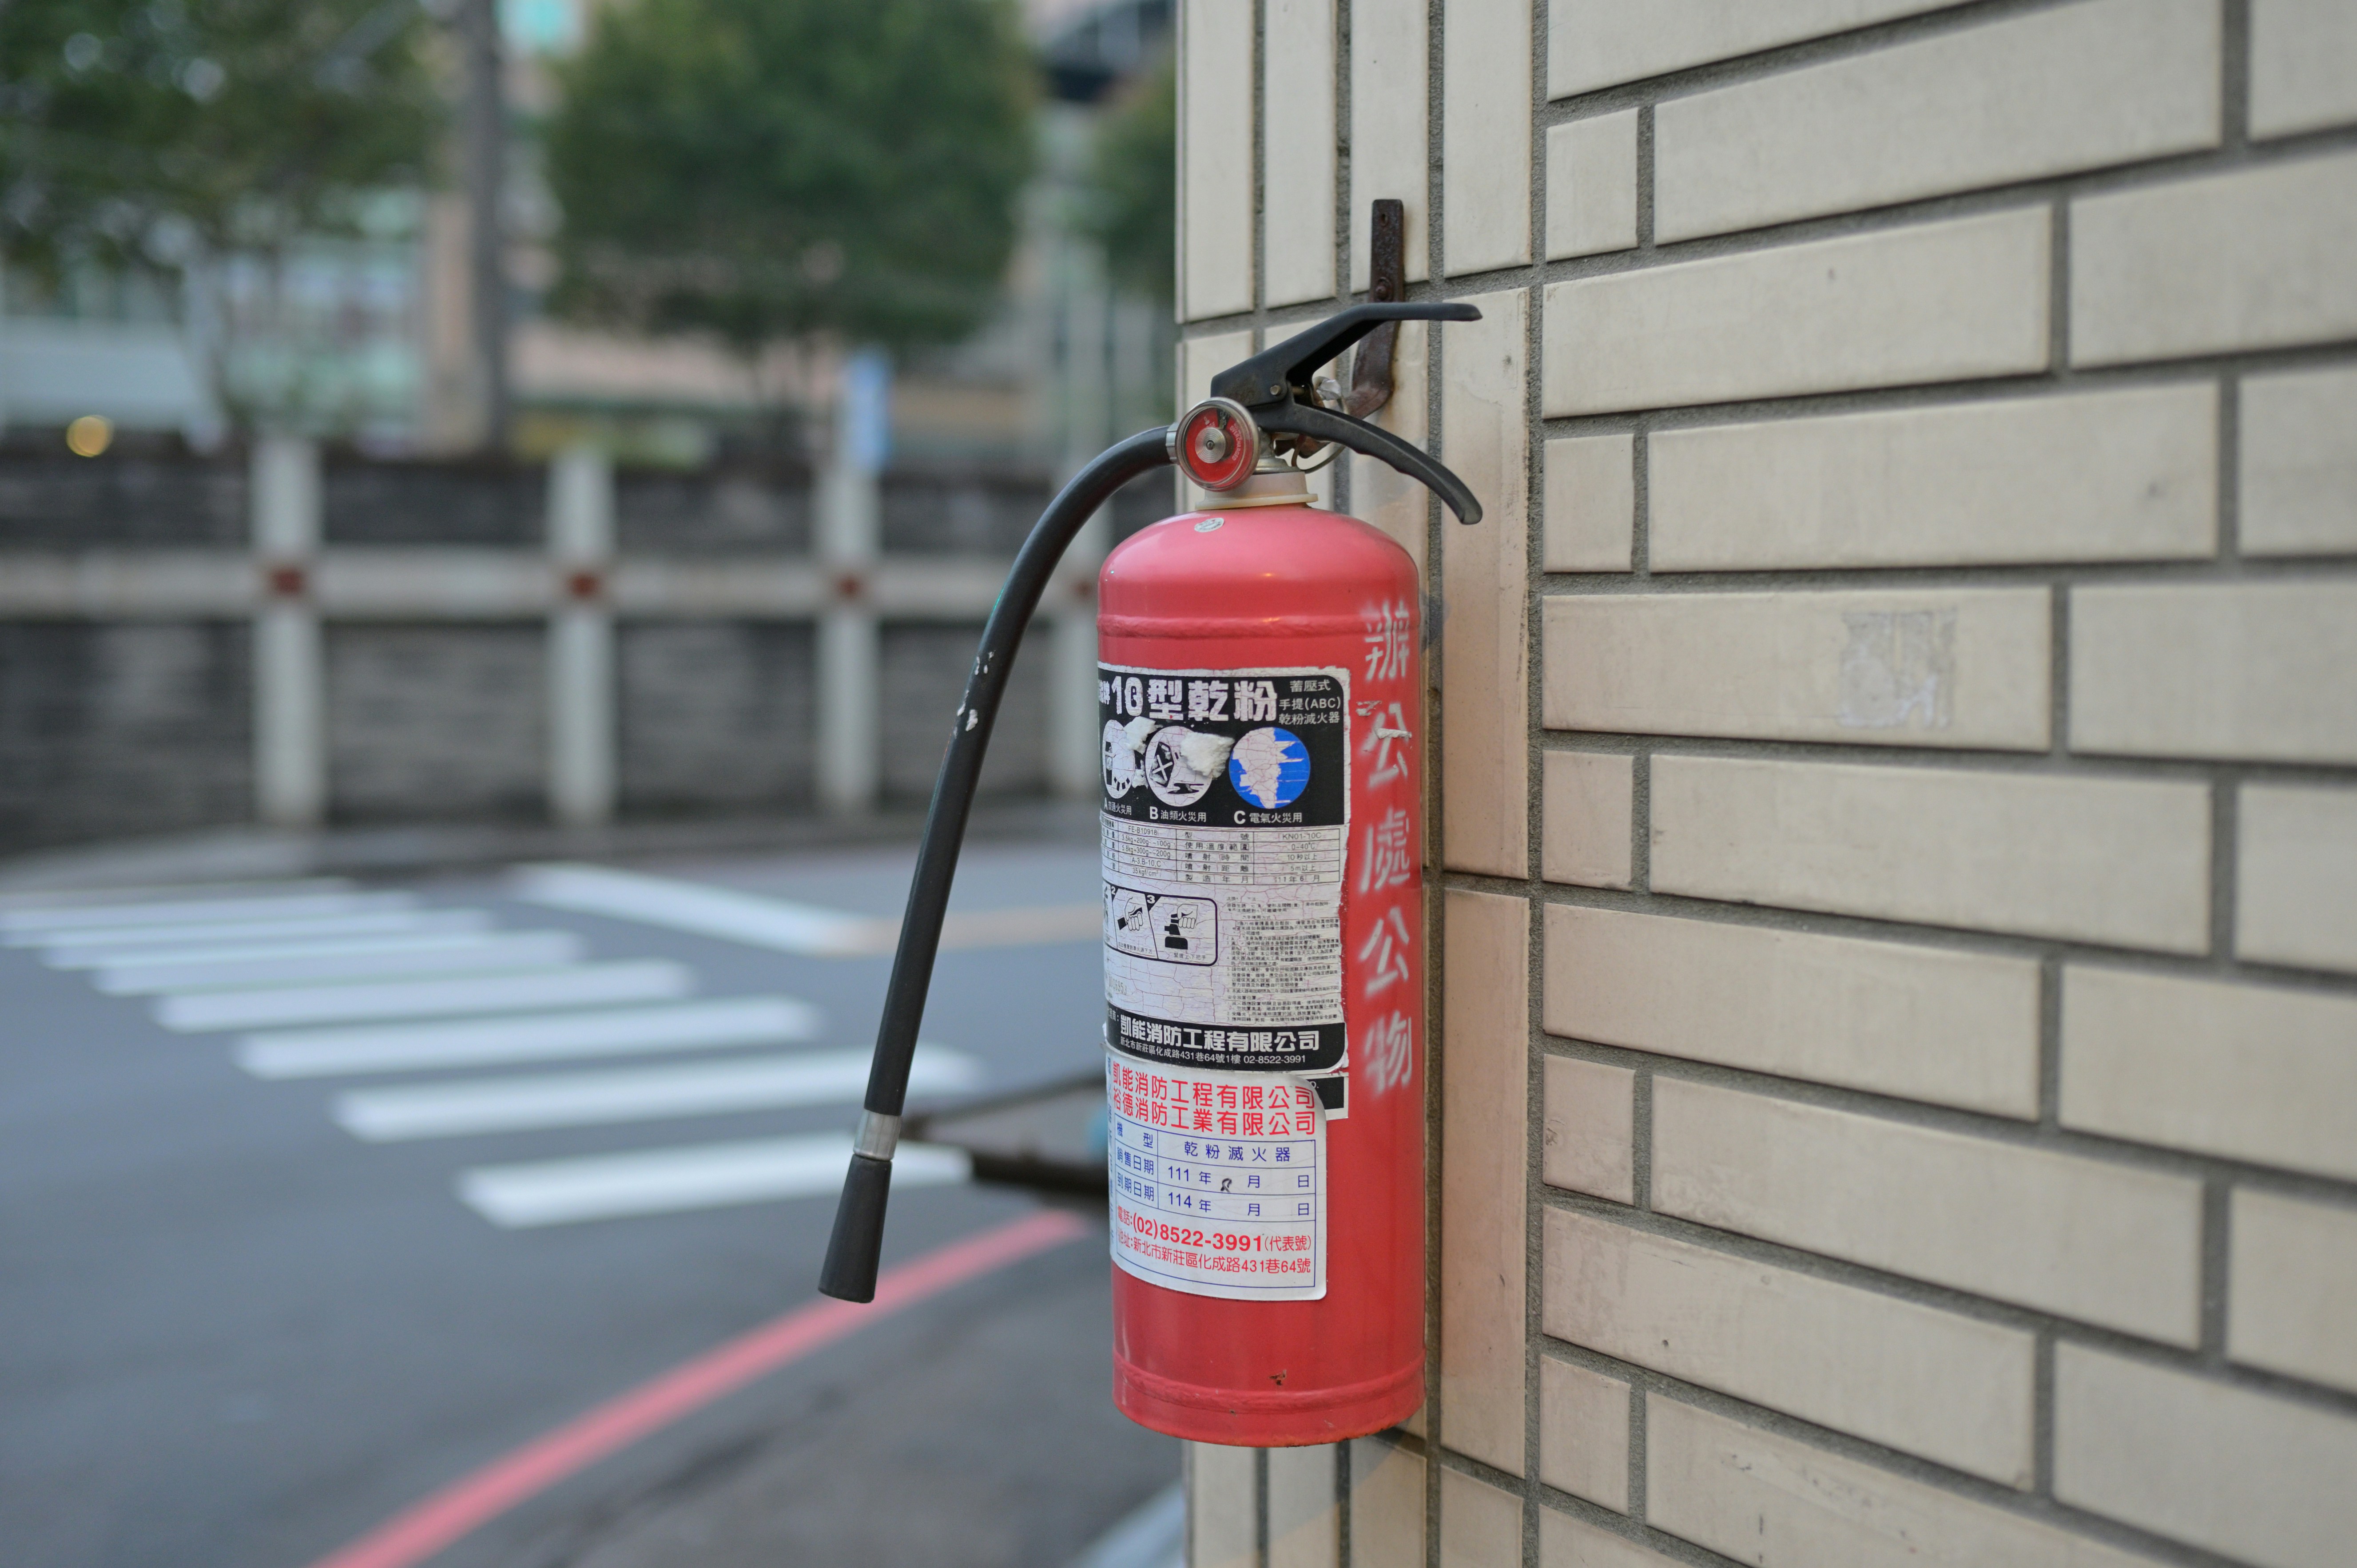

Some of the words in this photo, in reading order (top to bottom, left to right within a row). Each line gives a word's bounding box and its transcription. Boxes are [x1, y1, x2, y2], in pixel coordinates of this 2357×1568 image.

[1290, 679, 1331, 692] 蓄壓式
[1279, 696, 1341, 711] 手提(ABC)
[1149, 806, 1158, 819] B
[1161, 810, 1207, 822] 油類火災用
[1234, 810, 1246, 824] C
[1249, 812, 1303, 823] 電氣火災用
[1147, 895, 1155, 904] 3
[1121, 1014, 1320, 1052] 凱能消防工程有限公司
[1120, 1036, 1241, 1064] 新北市新莊區化成路431巷64號1樓
[1244, 1054, 1306, 1064] 02-8522-3991
[1113, 1061, 1315, 1110] 凱能消防工程有限公司
[1113, 1085, 1315, 1136] 裕德消防工業有限公司
[1117, 1146, 1154, 1176] 銷售日期
[1184, 1141, 1291, 1162] 乾粉滅火器
[1117, 1171, 1154, 1202] 到期日期
